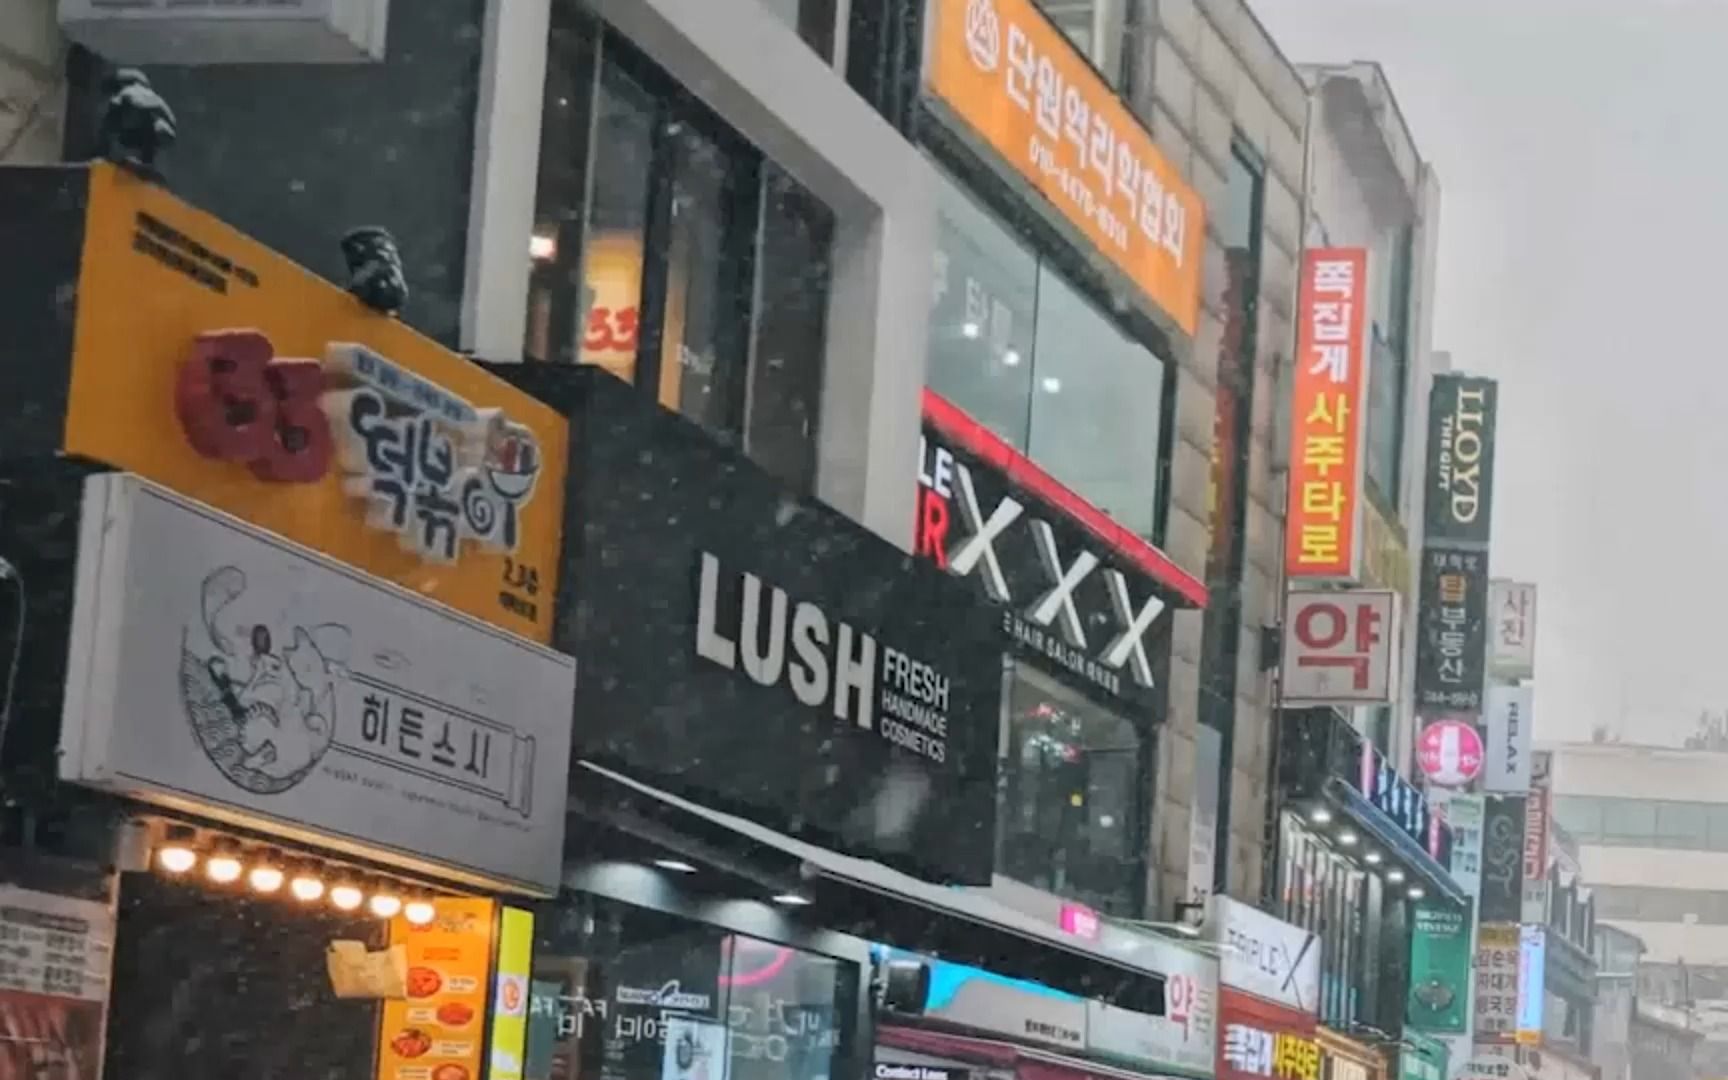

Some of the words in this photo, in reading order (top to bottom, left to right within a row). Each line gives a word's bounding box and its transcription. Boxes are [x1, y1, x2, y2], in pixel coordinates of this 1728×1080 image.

[1298, 392, 1351, 564] 사주타로
[1452, 386, 1484, 524] LLOYD
[697, 551, 877, 729] LUSH
[1294, 602, 1382, 691] 약
[1438, 605, 1466, 683] 부동산
[1501, 590, 1530, 648] 사진
[882, 690, 948, 737] HANDMADE
[883, 646, 949, 711] FRESH
[362, 695, 490, 777] 히든스시
[880, 716, 945, 763] COSMETICS
[1505, 701, 1518, 775] RELAX
[1169, 974, 1194, 1042] 약
